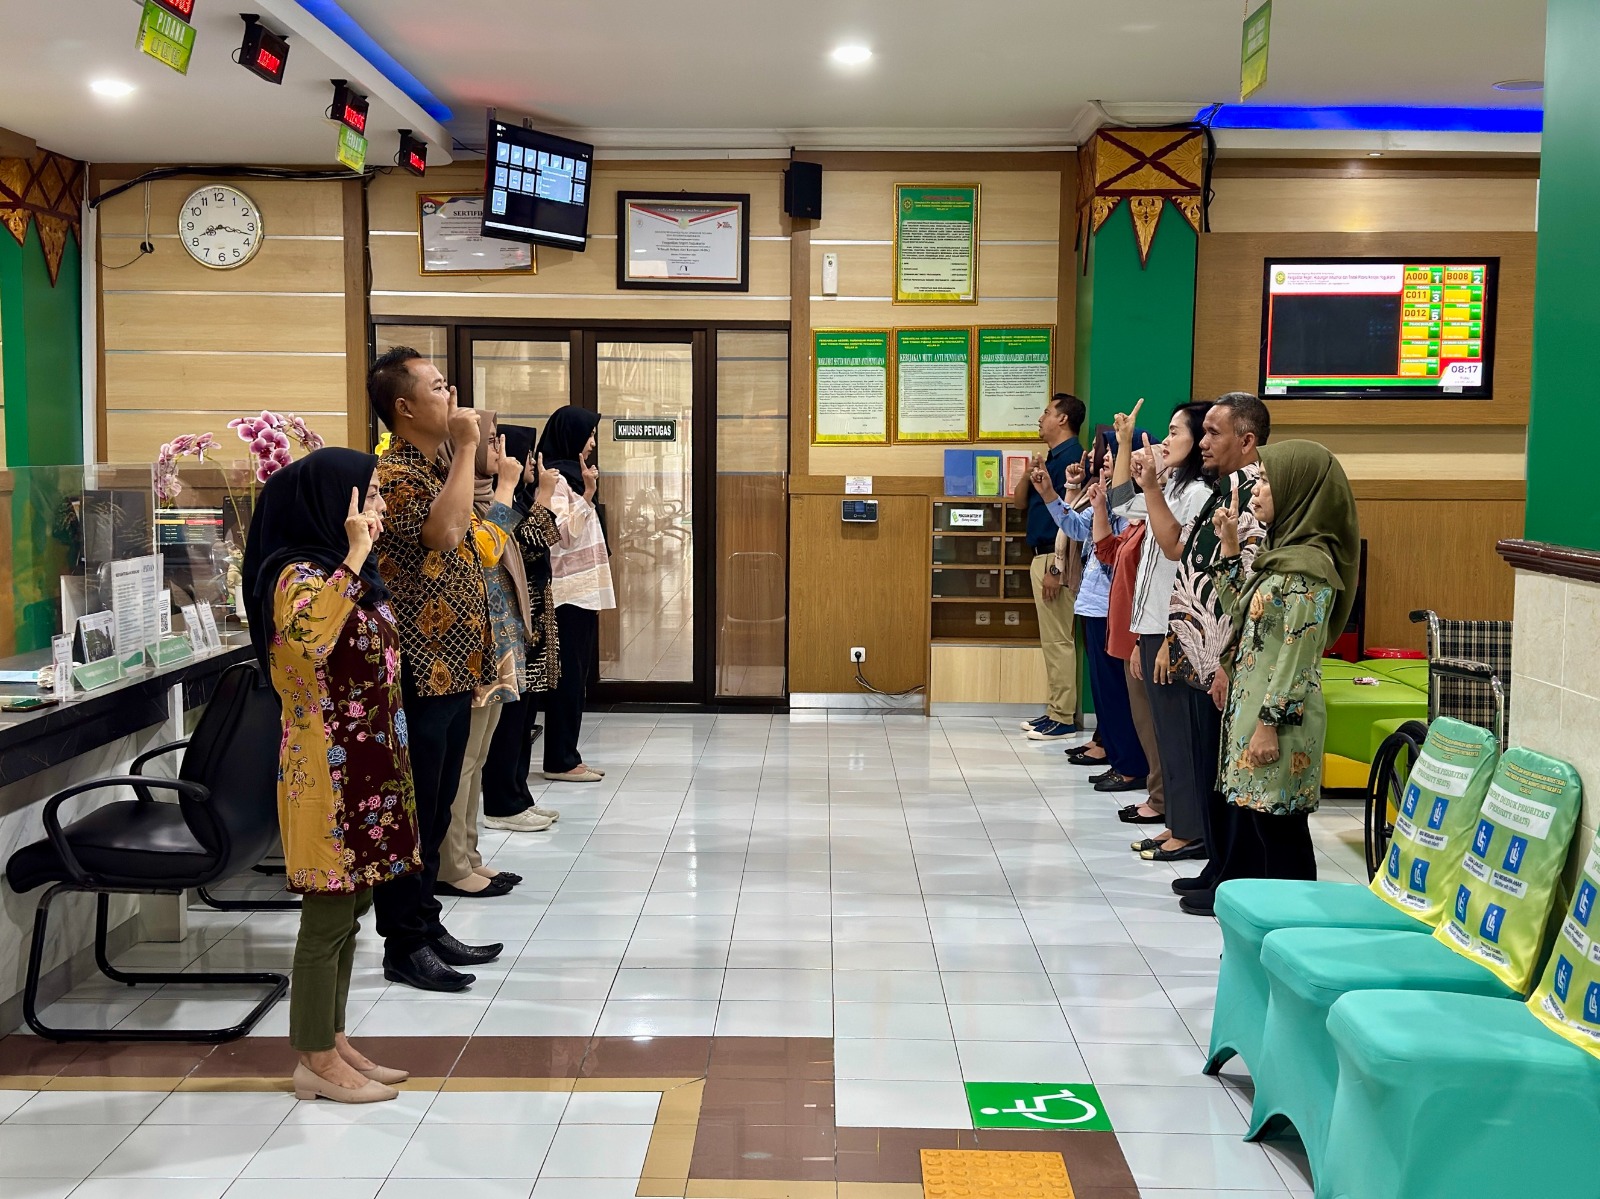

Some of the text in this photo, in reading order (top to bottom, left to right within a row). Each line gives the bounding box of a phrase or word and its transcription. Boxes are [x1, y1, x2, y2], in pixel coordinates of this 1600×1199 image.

[156, 11, 186, 45] PIDANA
[201, 197, 208, 206] 11
[214, 192, 224, 202] 12
[232, 197, 236, 206] 1
[191, 207, 202, 216] 10
[242, 208, 249, 216] 2
[186, 222, 194, 230] 9
[247, 222, 254, 231] 3
[192, 238, 200, 246] 8
[243, 238, 250, 246] 4
[203, 248, 210, 257] 7
[218, 252, 226, 262] 6
[232, 248, 240, 257] 5
[1406, 272, 1428, 280] A000
[1434, 276, 1440, 284] 1
[1446, 272, 1468, 280] B008
[1474, 276, 1480, 284] 2
[1432, 294, 1440, 302] 3
[1432, 312, 1438, 320] 5
[900, 354, 922, 362] KEBIJAKAN
[934, 354, 943, 362] ANTI
[618, 425, 672, 436] KHUSUS PETUGAS
[1517, 802, 1550, 820] PRIORITAS
[1512, 813, 1530, 828] SEATS)
